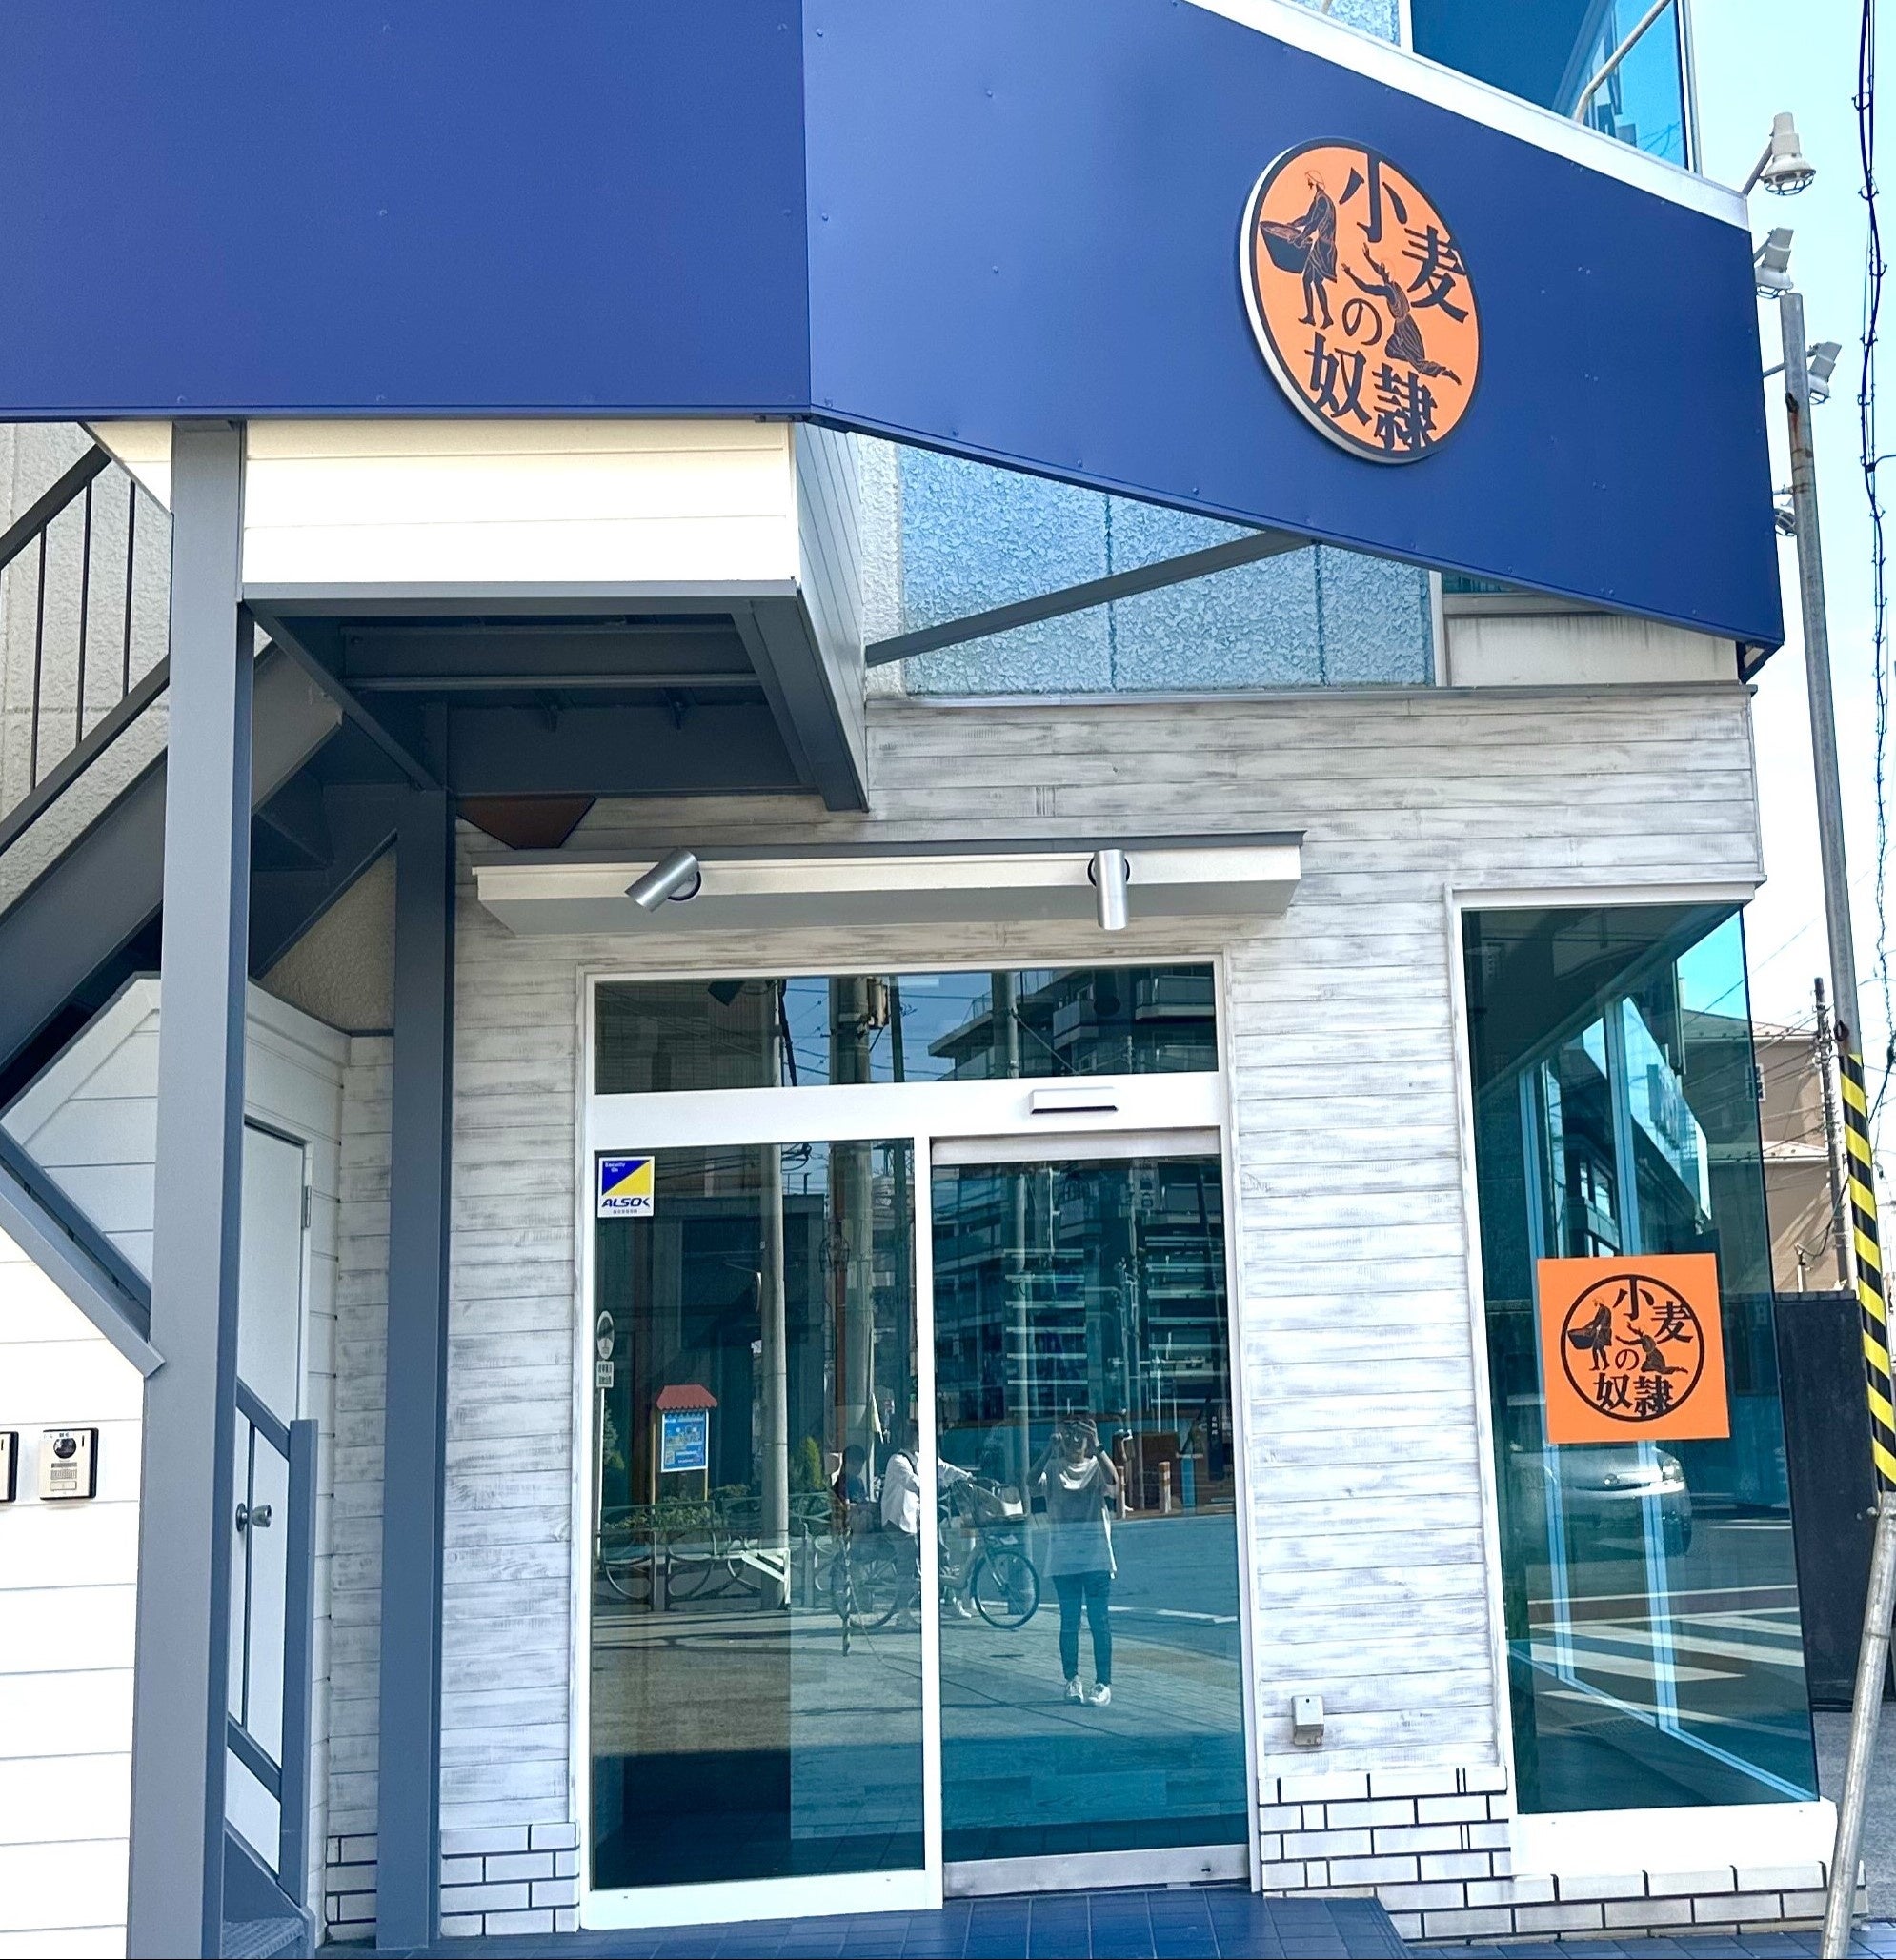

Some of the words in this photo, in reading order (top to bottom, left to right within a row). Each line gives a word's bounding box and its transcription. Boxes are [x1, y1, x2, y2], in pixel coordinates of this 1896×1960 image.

[1341, 297, 1382, 346] の
[1304, 331, 1438, 451] 奴隷
[602, 1197, 650, 1208] ALSOK
[1614, 1348, 1640, 1371] の
[1593, 1372, 1674, 1416] 奴隷
